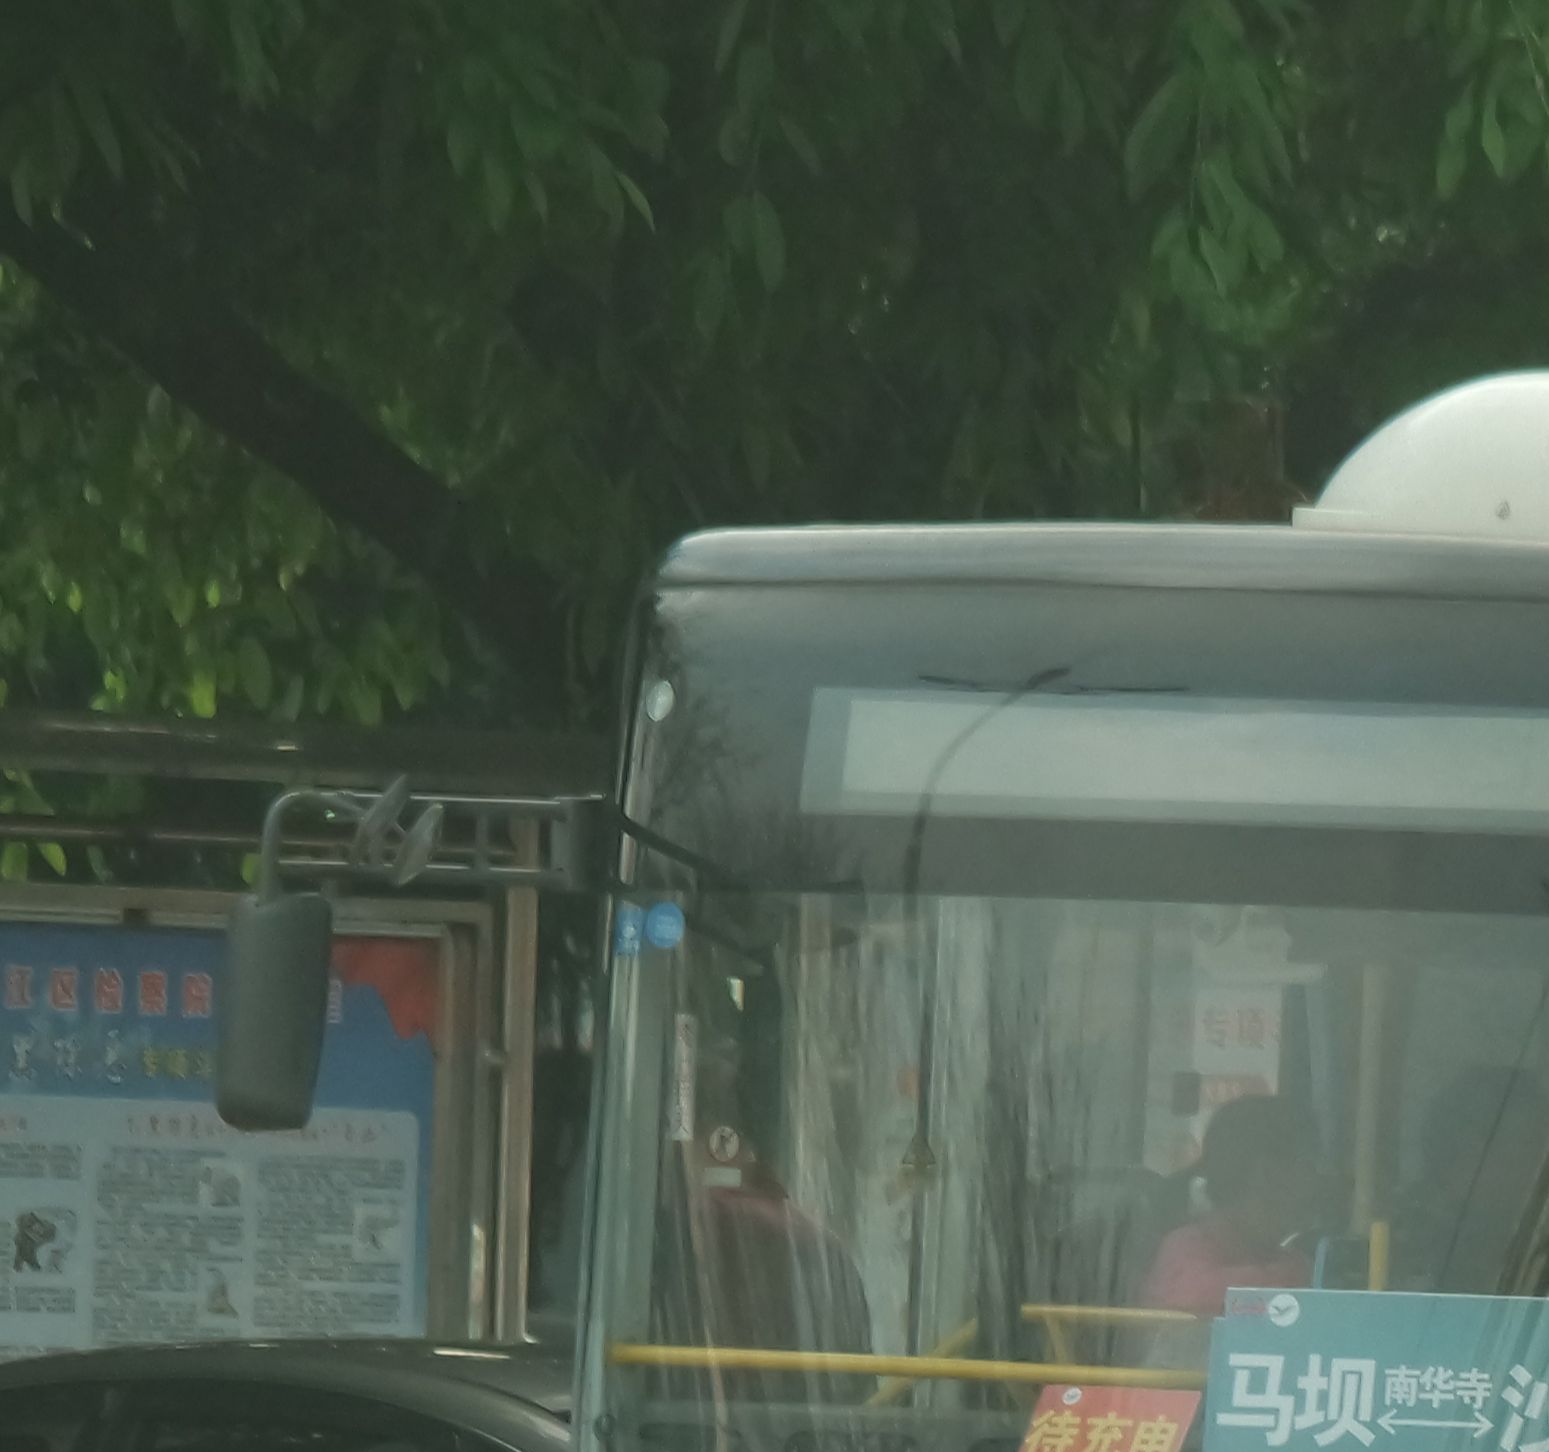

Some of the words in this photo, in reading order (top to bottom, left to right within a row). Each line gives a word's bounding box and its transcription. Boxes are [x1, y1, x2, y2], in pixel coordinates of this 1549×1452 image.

[1216, 1353, 1376, 1447] 马坝
[1384, 1364, 1493, 1409] 南华寺
